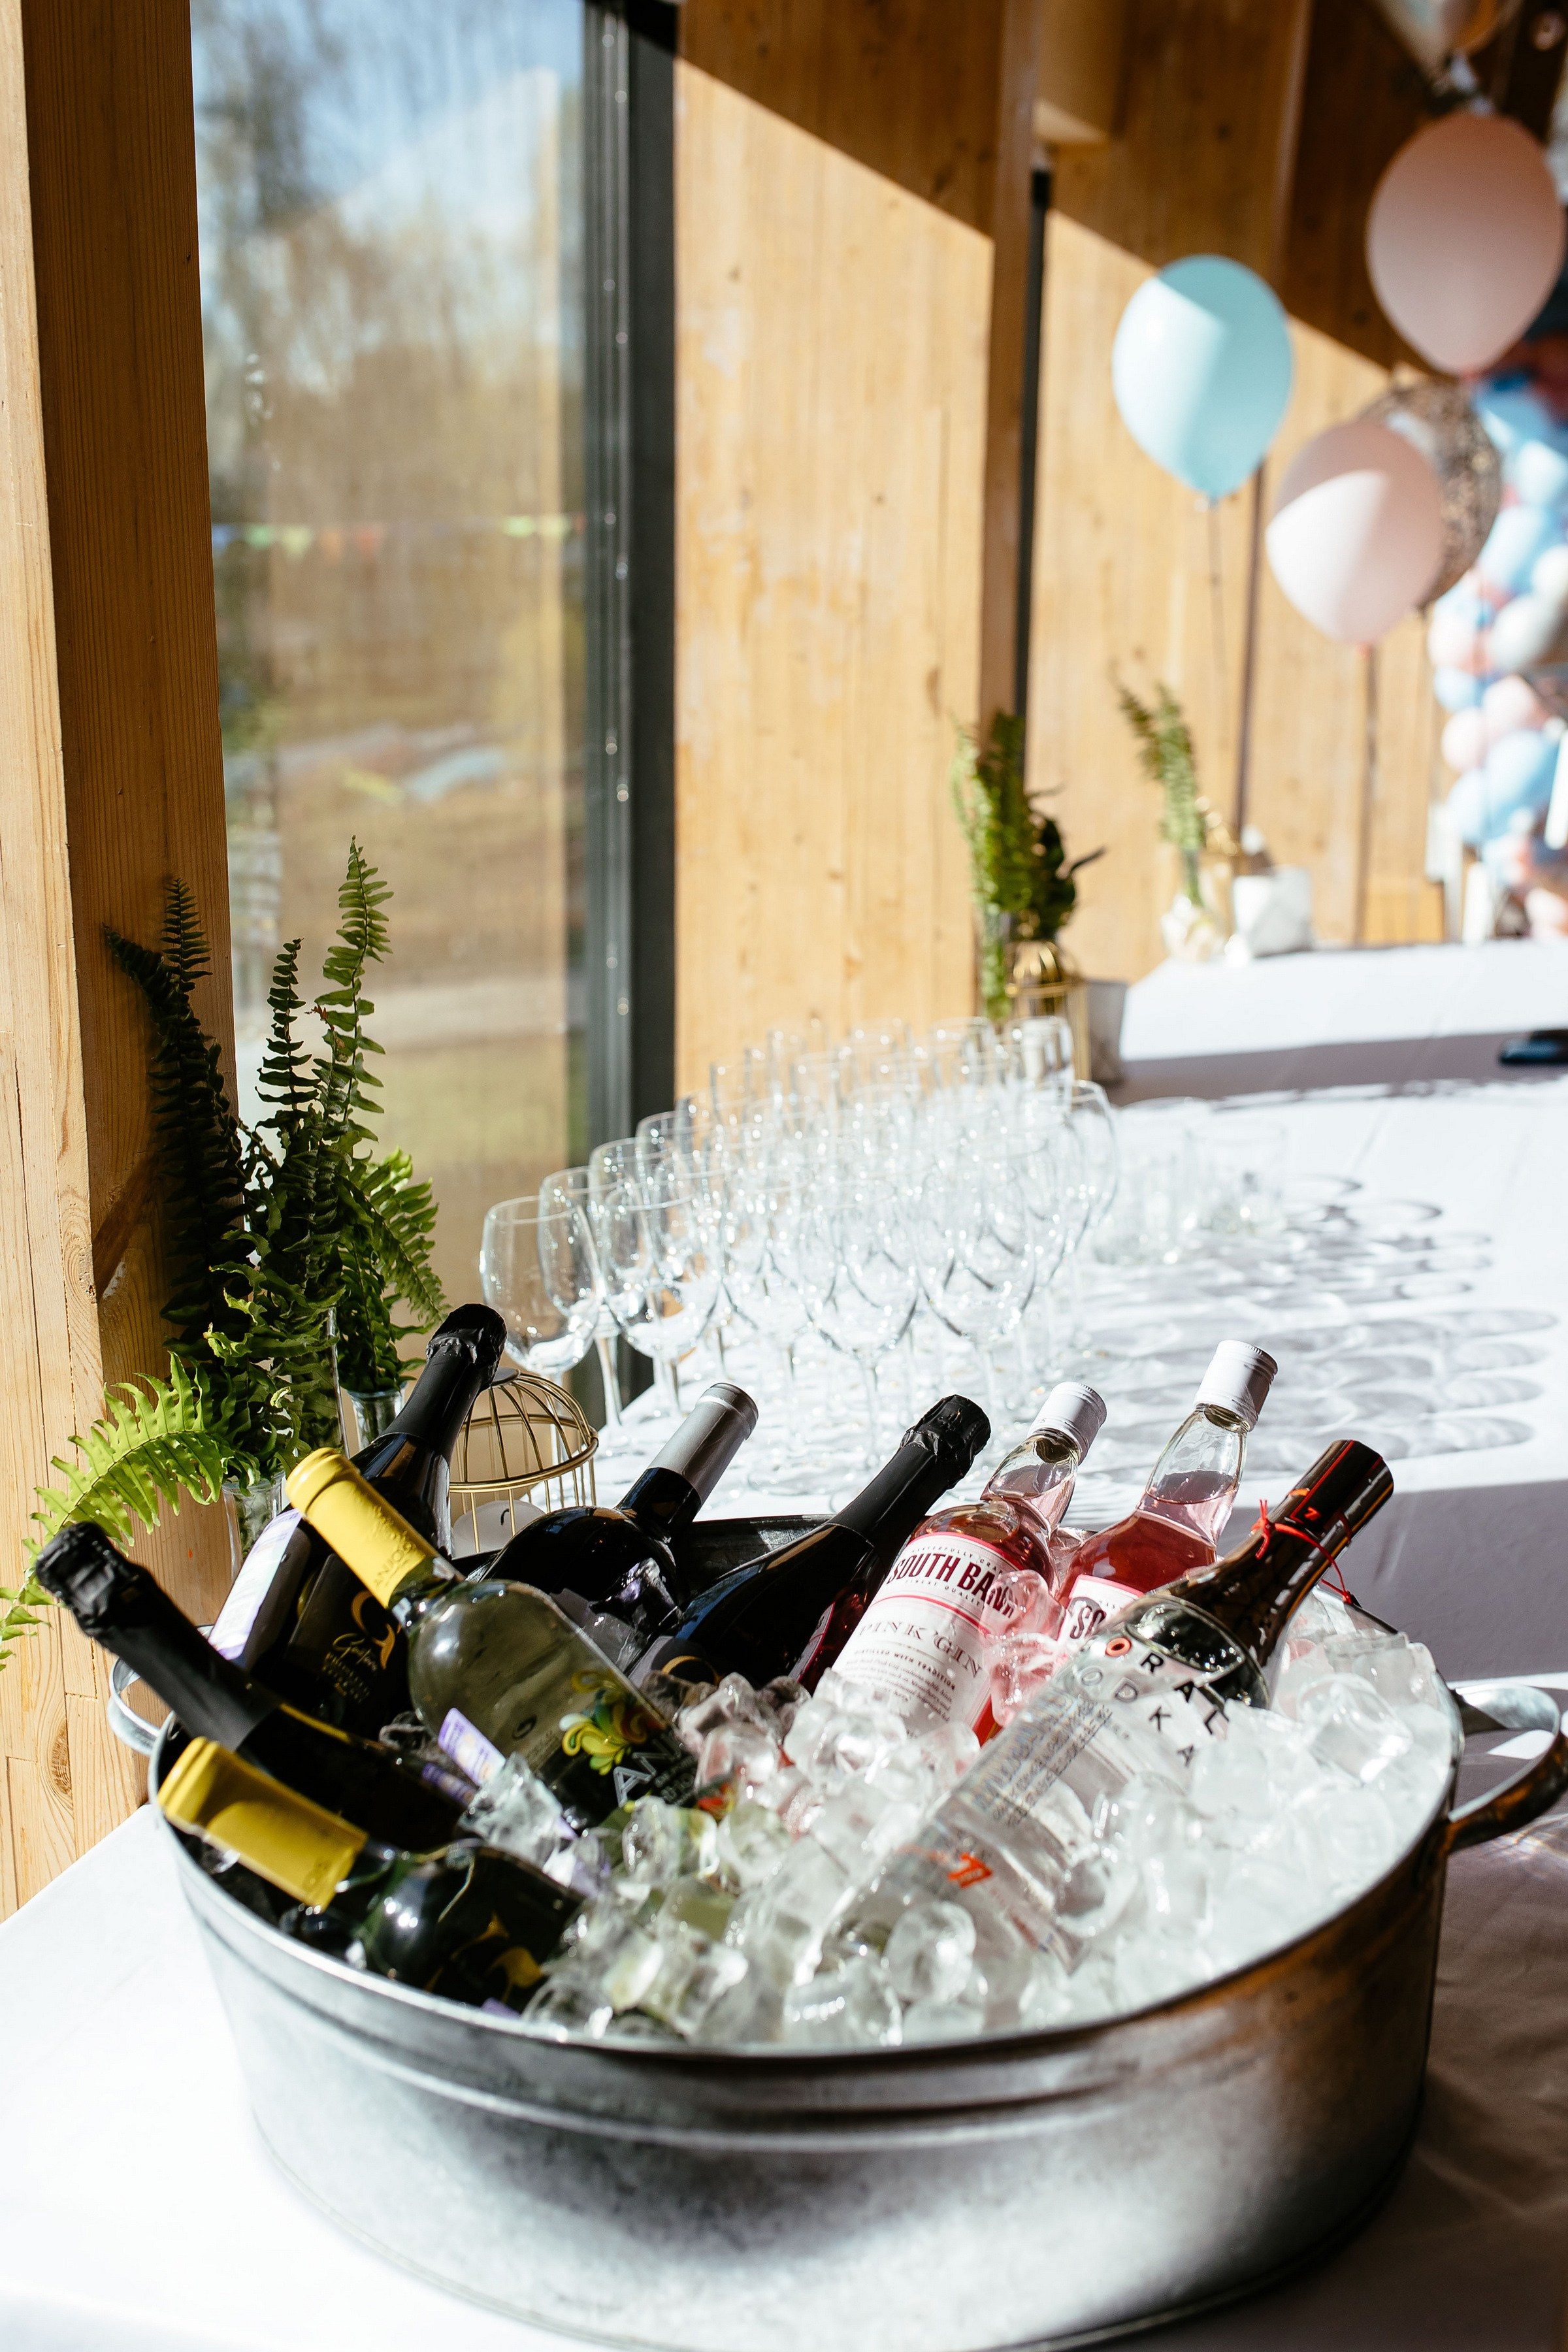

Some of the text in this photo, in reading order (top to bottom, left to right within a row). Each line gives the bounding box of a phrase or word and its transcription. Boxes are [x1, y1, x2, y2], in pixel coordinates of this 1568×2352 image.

[887, 1552, 961, 1584] SOUTH
[979, 1558, 1003, 1575] CRAF
[945, 1584, 980, 1607] QUALIT
[859, 1621, 982, 1678] PINK GIN
[894, 1652, 914, 1663] WITH
[918, 1661, 955, 1690] TRADITION
